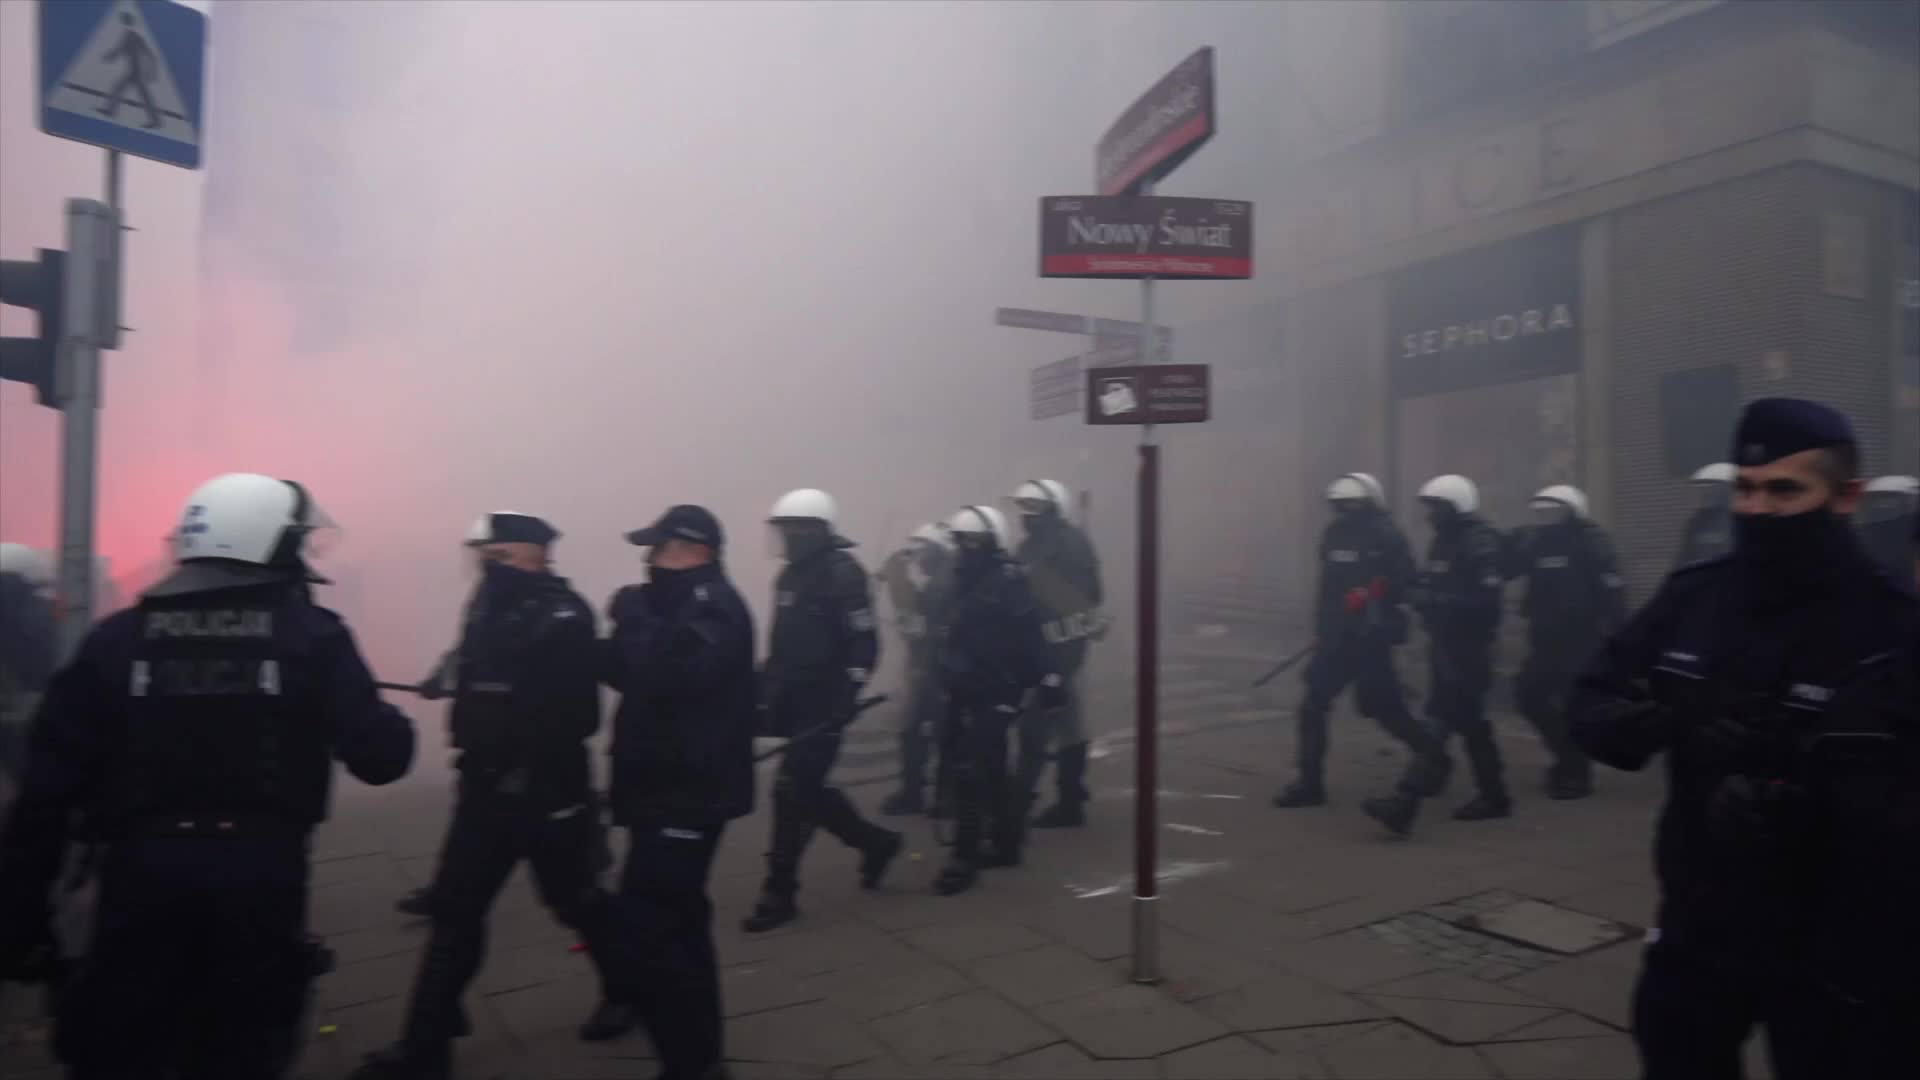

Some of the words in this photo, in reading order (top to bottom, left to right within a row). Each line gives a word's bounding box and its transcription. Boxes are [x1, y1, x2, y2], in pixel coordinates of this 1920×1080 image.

[1067, 215, 1154, 254] Nowy
[1158, 207, 1233, 247] Świat
[1401, 303, 1574, 358] SEPHORA
[144, 609, 274, 639] POLICJA
